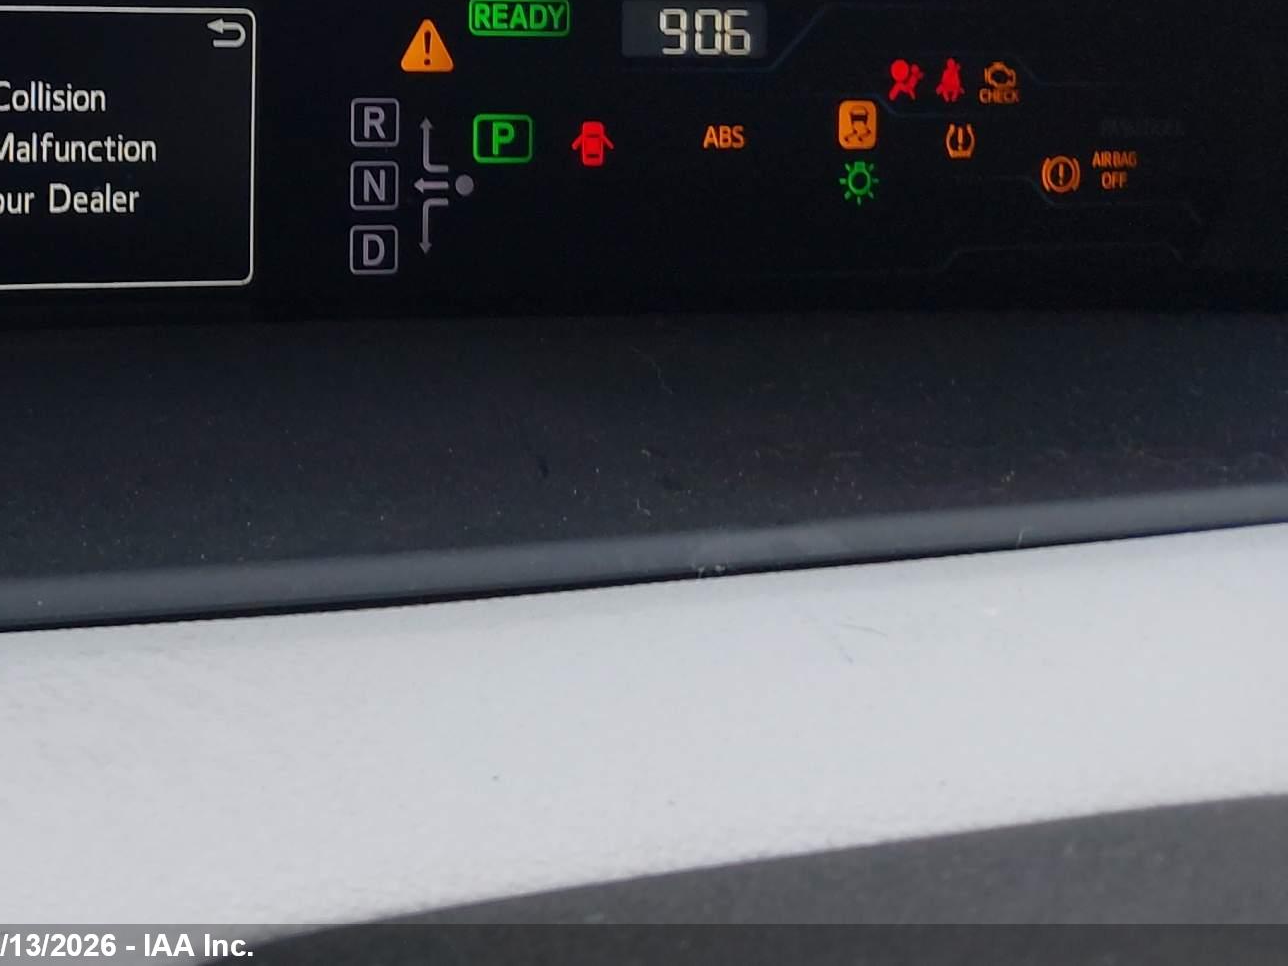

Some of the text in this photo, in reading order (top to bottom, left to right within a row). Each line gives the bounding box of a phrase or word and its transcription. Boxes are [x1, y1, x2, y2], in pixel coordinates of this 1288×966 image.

[474, 3, 564, 29] READY
[659, 8, 751, 55] 906
[979, 88, 1020, 104] CHECK
[364, 105, 386, 139] R
[703, 126, 745, 149] ABS
[492, 122, 515, 156] P
[1092, 151, 1138, 169] AIRBAG
[364, 170, 386, 202] N
[1102, 171, 1127, 190] OFF
[49, 183, 140, 214] Dealer
[363, 234, 385, 267] D
